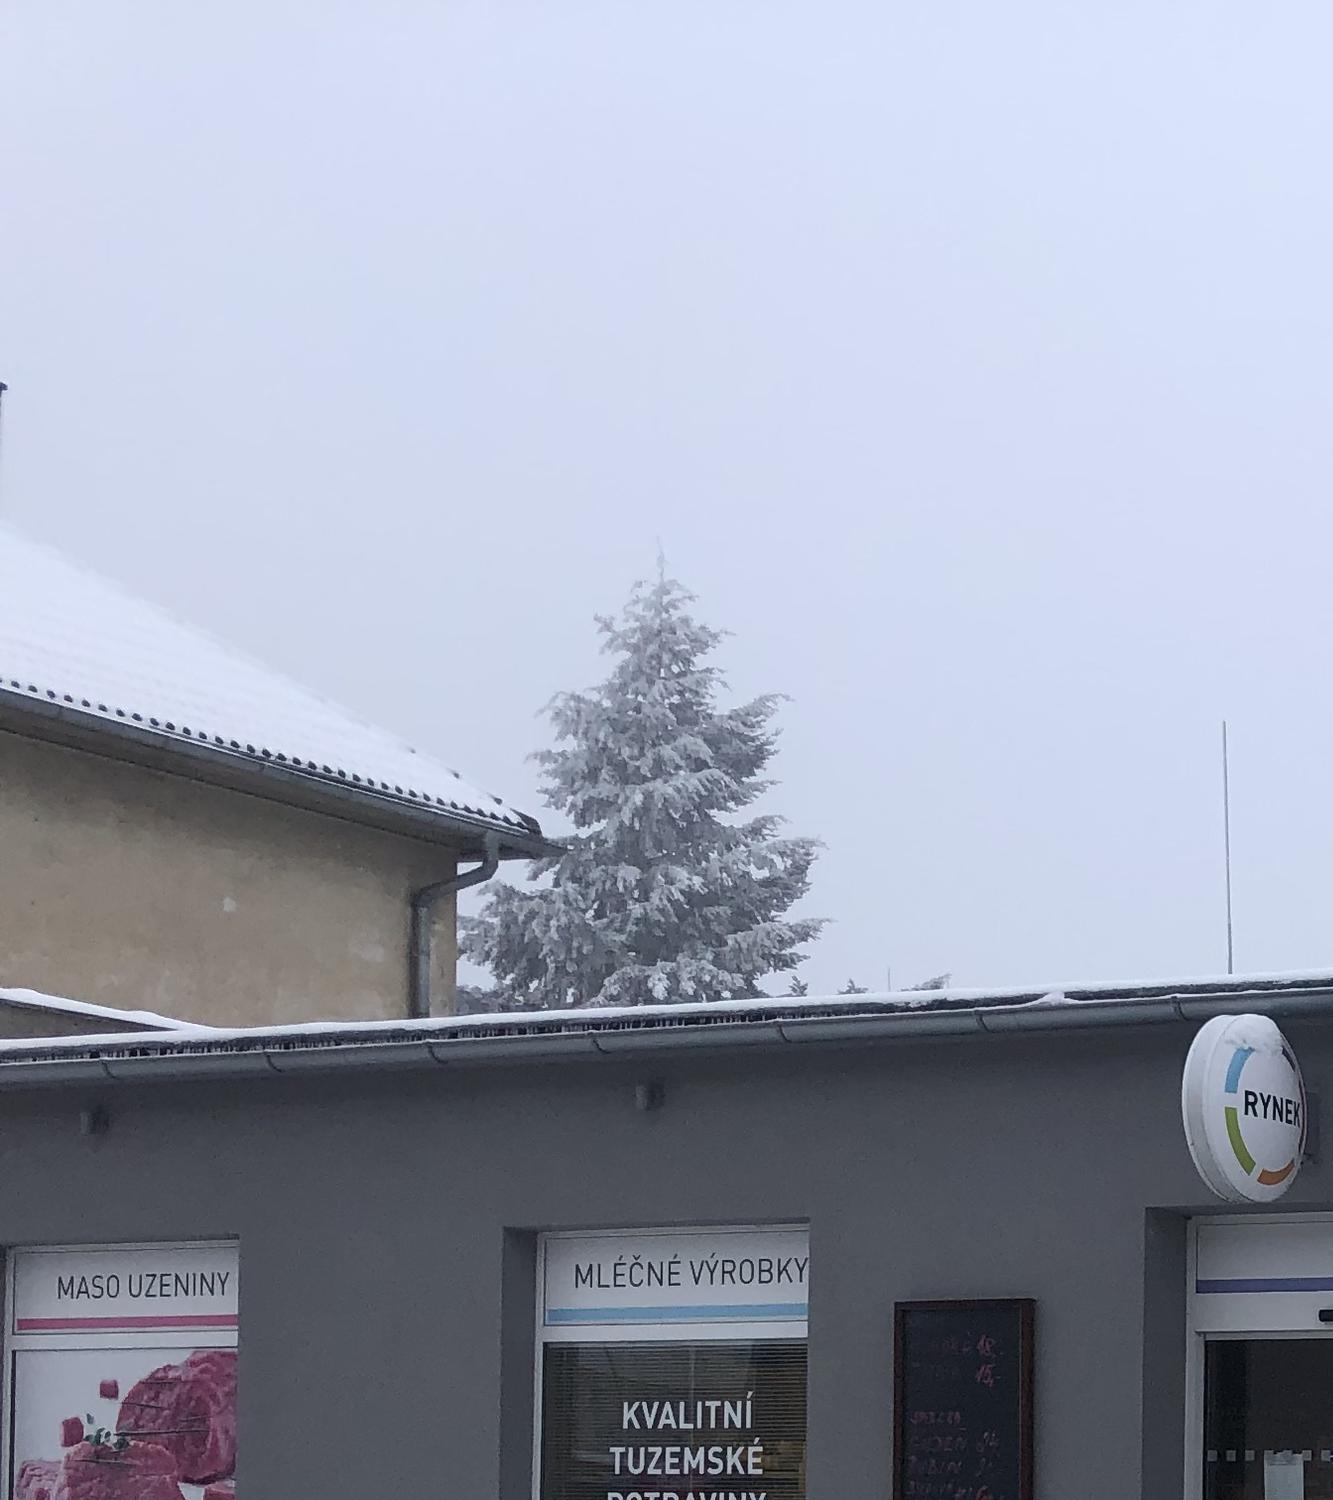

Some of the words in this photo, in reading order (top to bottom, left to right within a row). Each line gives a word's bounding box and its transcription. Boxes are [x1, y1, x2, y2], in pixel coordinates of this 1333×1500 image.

[1244, 1090, 1300, 1128] RYNEK
[57, 1274, 120, 1299] MASO
[128, 1271, 230, 1298] UZENINY
[574, 1254, 681, 1289] MLÉČNÉ
[689, 1252, 809, 1286] VÝROBKY
[622, 1391, 753, 1430] KVALITNÍ
[609, 1437, 764, 1475] TUZEMSKÉ
